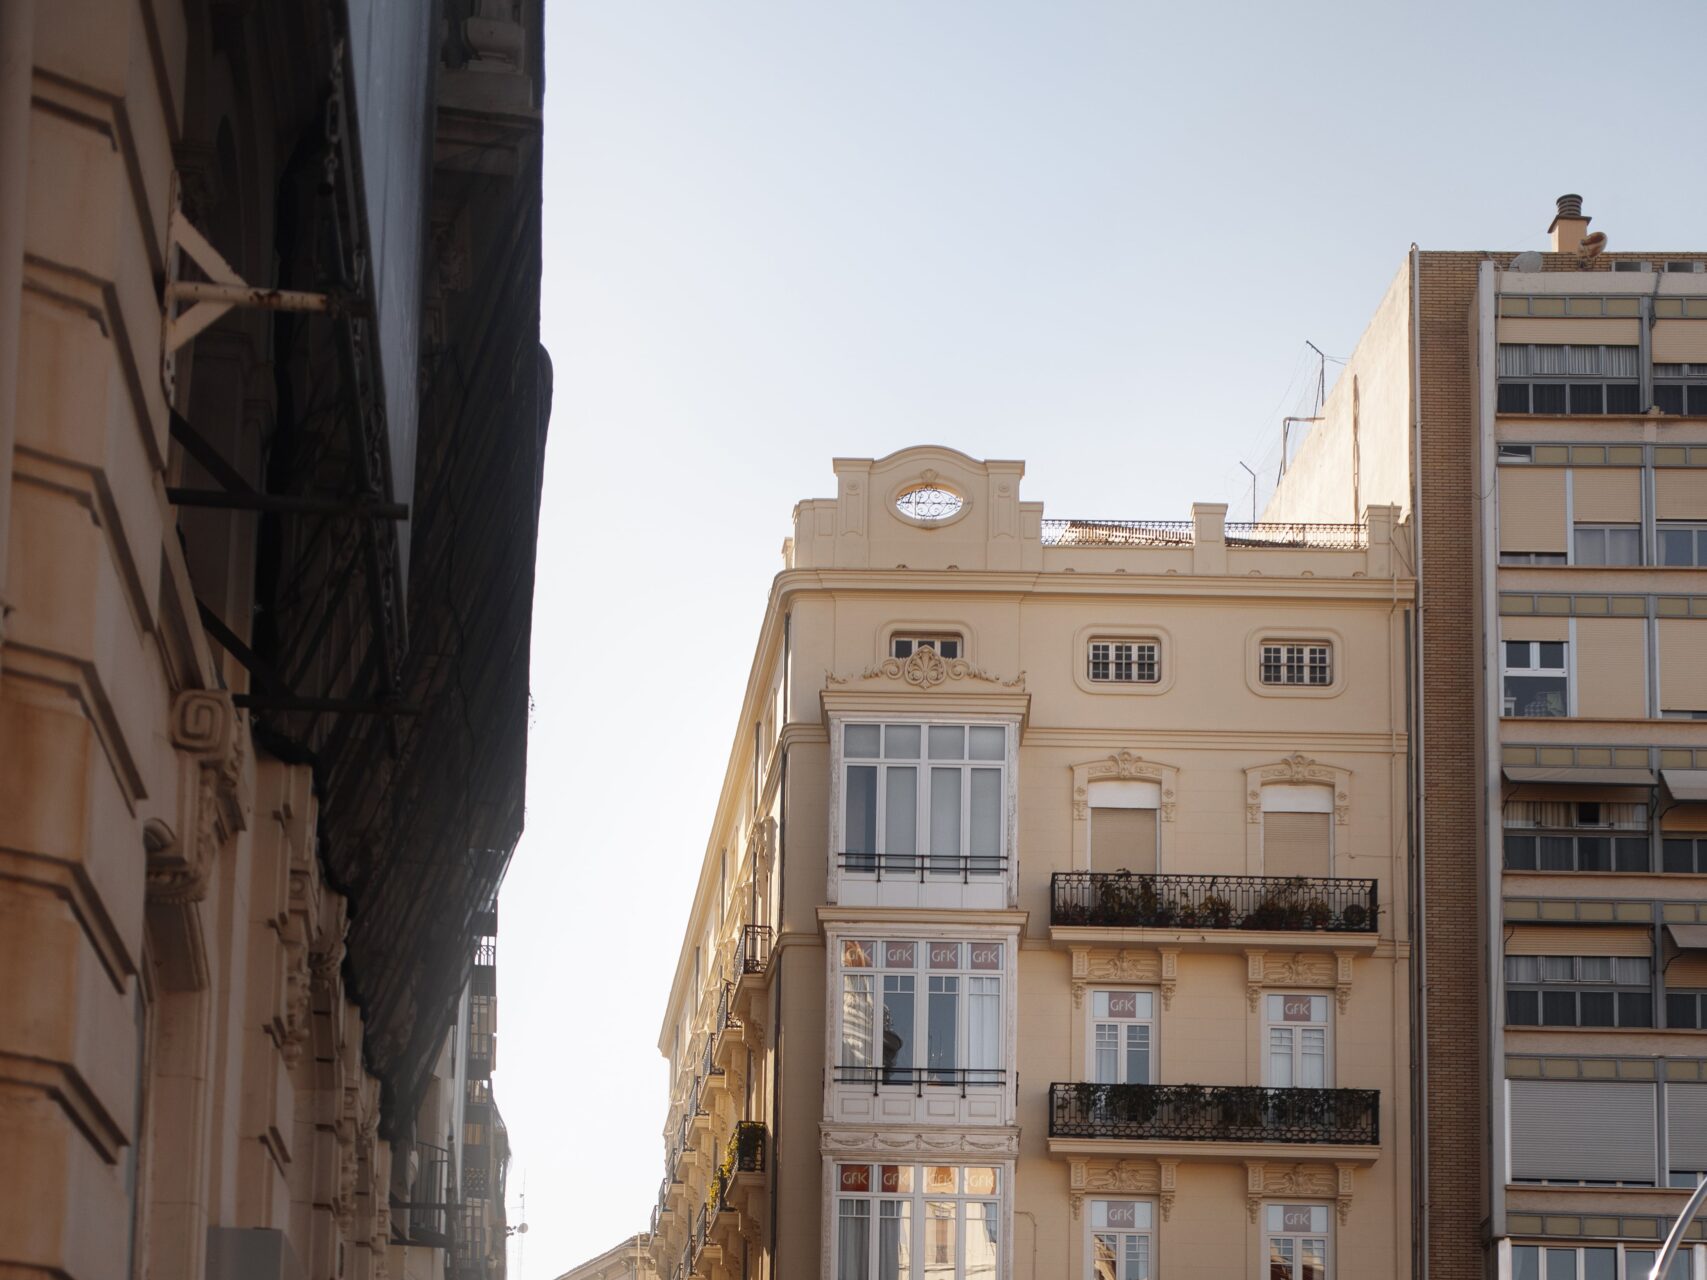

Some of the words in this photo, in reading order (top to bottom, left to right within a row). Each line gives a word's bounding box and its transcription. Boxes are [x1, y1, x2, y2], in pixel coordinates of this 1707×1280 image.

[887, 949, 912, 962] GfK
[931, 949, 956, 962] GfK
[973, 950, 998, 963] GfK
[1110, 999, 1134, 1012] GfK
[1285, 1003, 1309, 1015] GfK
[843, 1171, 869, 1185] GfK
[1109, 1208, 1133, 1221] GfK
[1284, 1213, 1309, 1225] GfK
